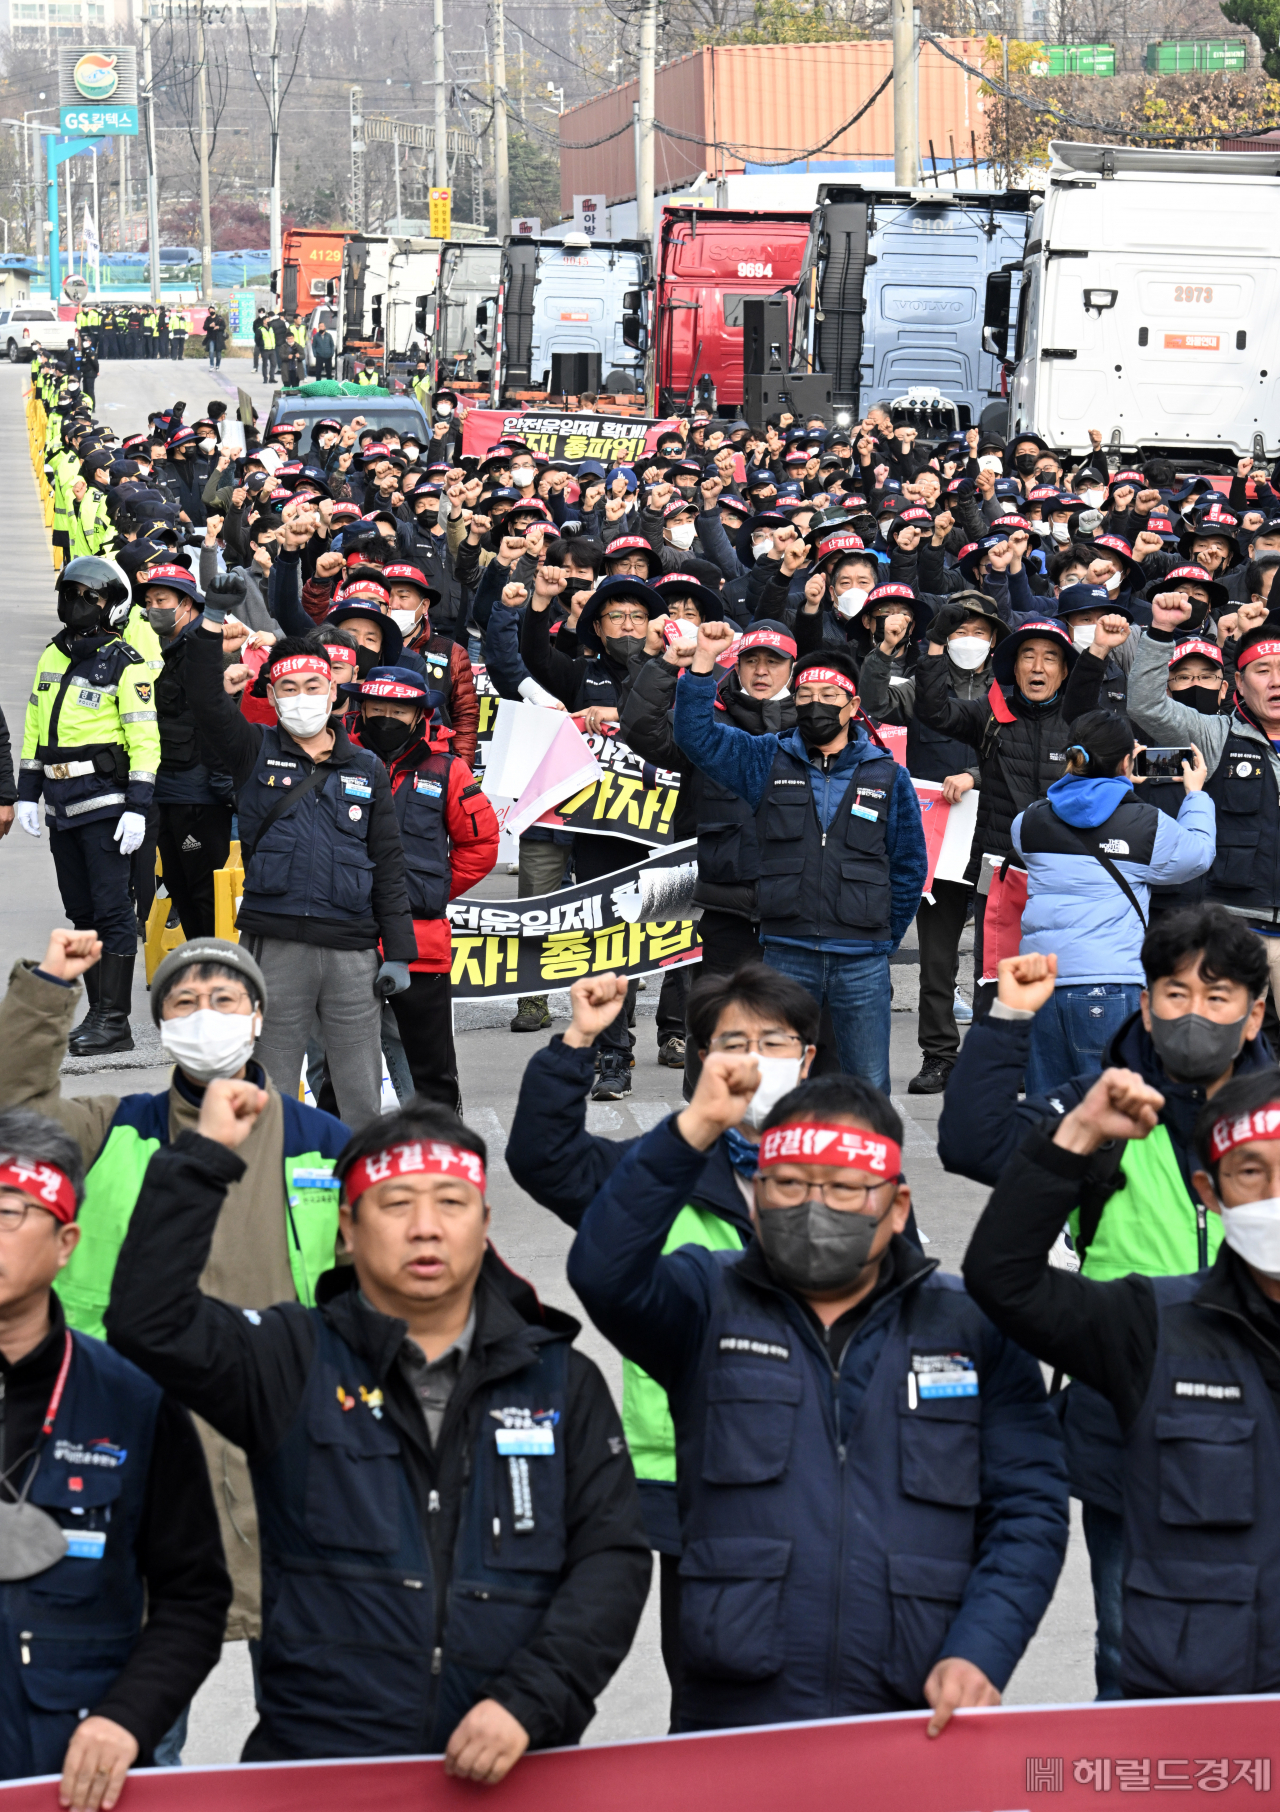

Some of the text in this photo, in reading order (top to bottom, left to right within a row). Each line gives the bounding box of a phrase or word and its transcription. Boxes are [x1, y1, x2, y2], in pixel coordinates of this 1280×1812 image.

[65, 113, 132, 129] GS 칼텍스
[912, 218, 955, 234] 8104
[309, 249, 341, 262] 4129
[563, 256, 589, 266] 9045
[709, 244, 802, 263] SCANIA
[737, 263, 773, 278] 9694
[1174, 285, 1213, 304] 2973
[895, 300, 964, 313] VOLVO
[1185, 335, 1217, 347] 화물연대
[502, 416, 598, 438] 안전운임제
[601, 421, 647, 439] 확대!
[563, 434, 646, 463] 총파업!
[1147, 519, 1164, 530] 투쟁
[626, 536, 645, 547] 투쟁
[828, 538, 846, 550] 단결
[156, 566, 176, 576] 투쟁
[391, 565, 412, 576] 투쟁
[1190, 568, 1210, 581] 투쟁
[344, 582, 386, 597] 단결 투쟁
[869, 586, 887, 601] 단결
[756, 632, 781, 646] 투쟁
[328, 647, 349, 661] 투쟁
[1195, 643, 1218, 658] 투쟁
[1257, 643, 1280, 655] 단결
[272, 657, 329, 678] 단결 투쟁
[800, 670, 854, 692] 단결 투쟁
[81, 689, 101, 703] 경찰
[361, 683, 378, 695] 단결
[78, 699, 99, 708] POLICE
[558, 770, 680, 835] 가자!
[539, 920, 703, 981] 총파업
[1212, 1109, 1253, 1152] 단결
[764, 1126, 888, 1171] 단결 투쟁
[9, 1156, 63, 1203] 투쟁
